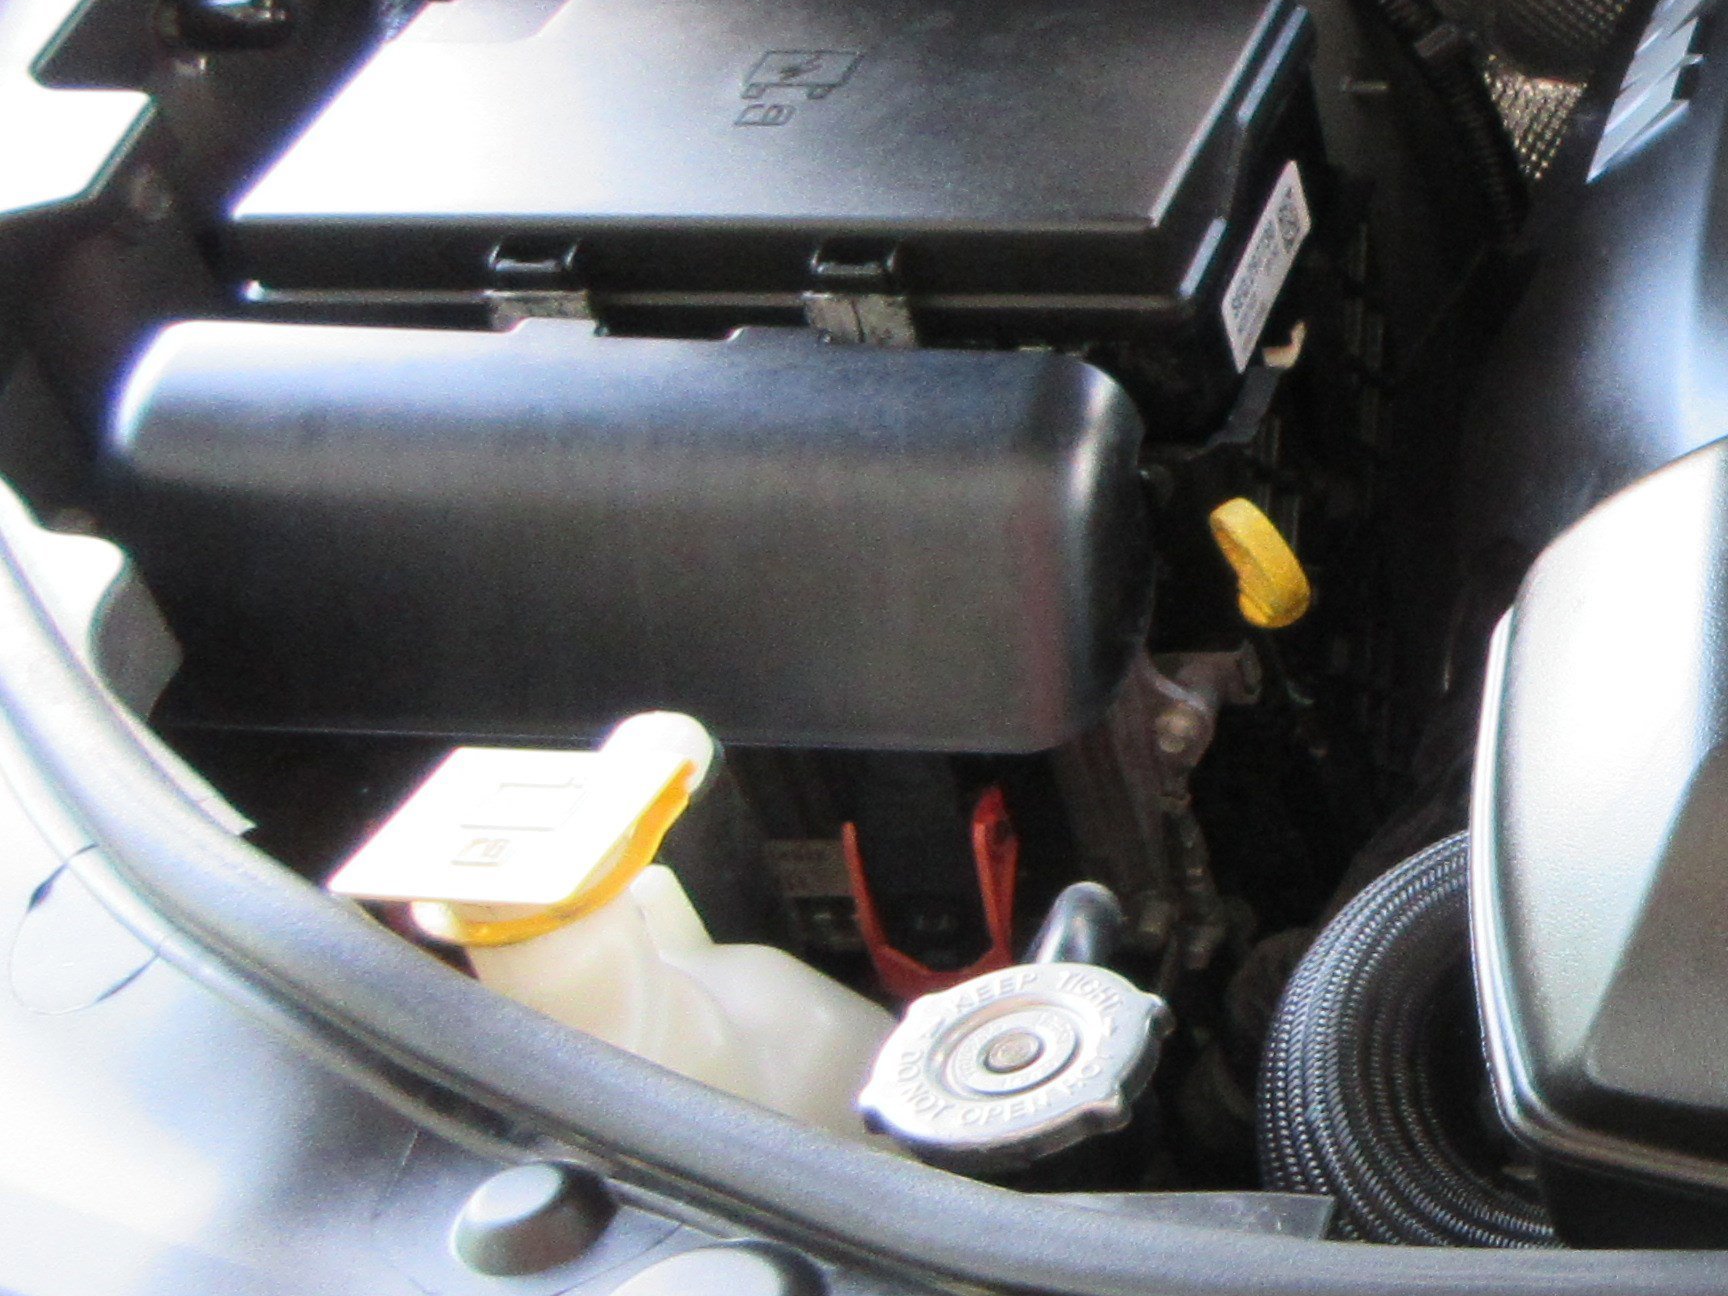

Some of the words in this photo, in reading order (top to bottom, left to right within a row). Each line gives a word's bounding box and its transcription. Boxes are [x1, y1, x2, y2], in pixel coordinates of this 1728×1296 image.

[954, 971, 1037, 1014] KEEP
[1056, 970, 1123, 1011] TIGHT
[898, 1050, 925, 1083] DO
[902, 1081, 956, 1120] NOT
[960, 1091, 1051, 1126] OPEN
